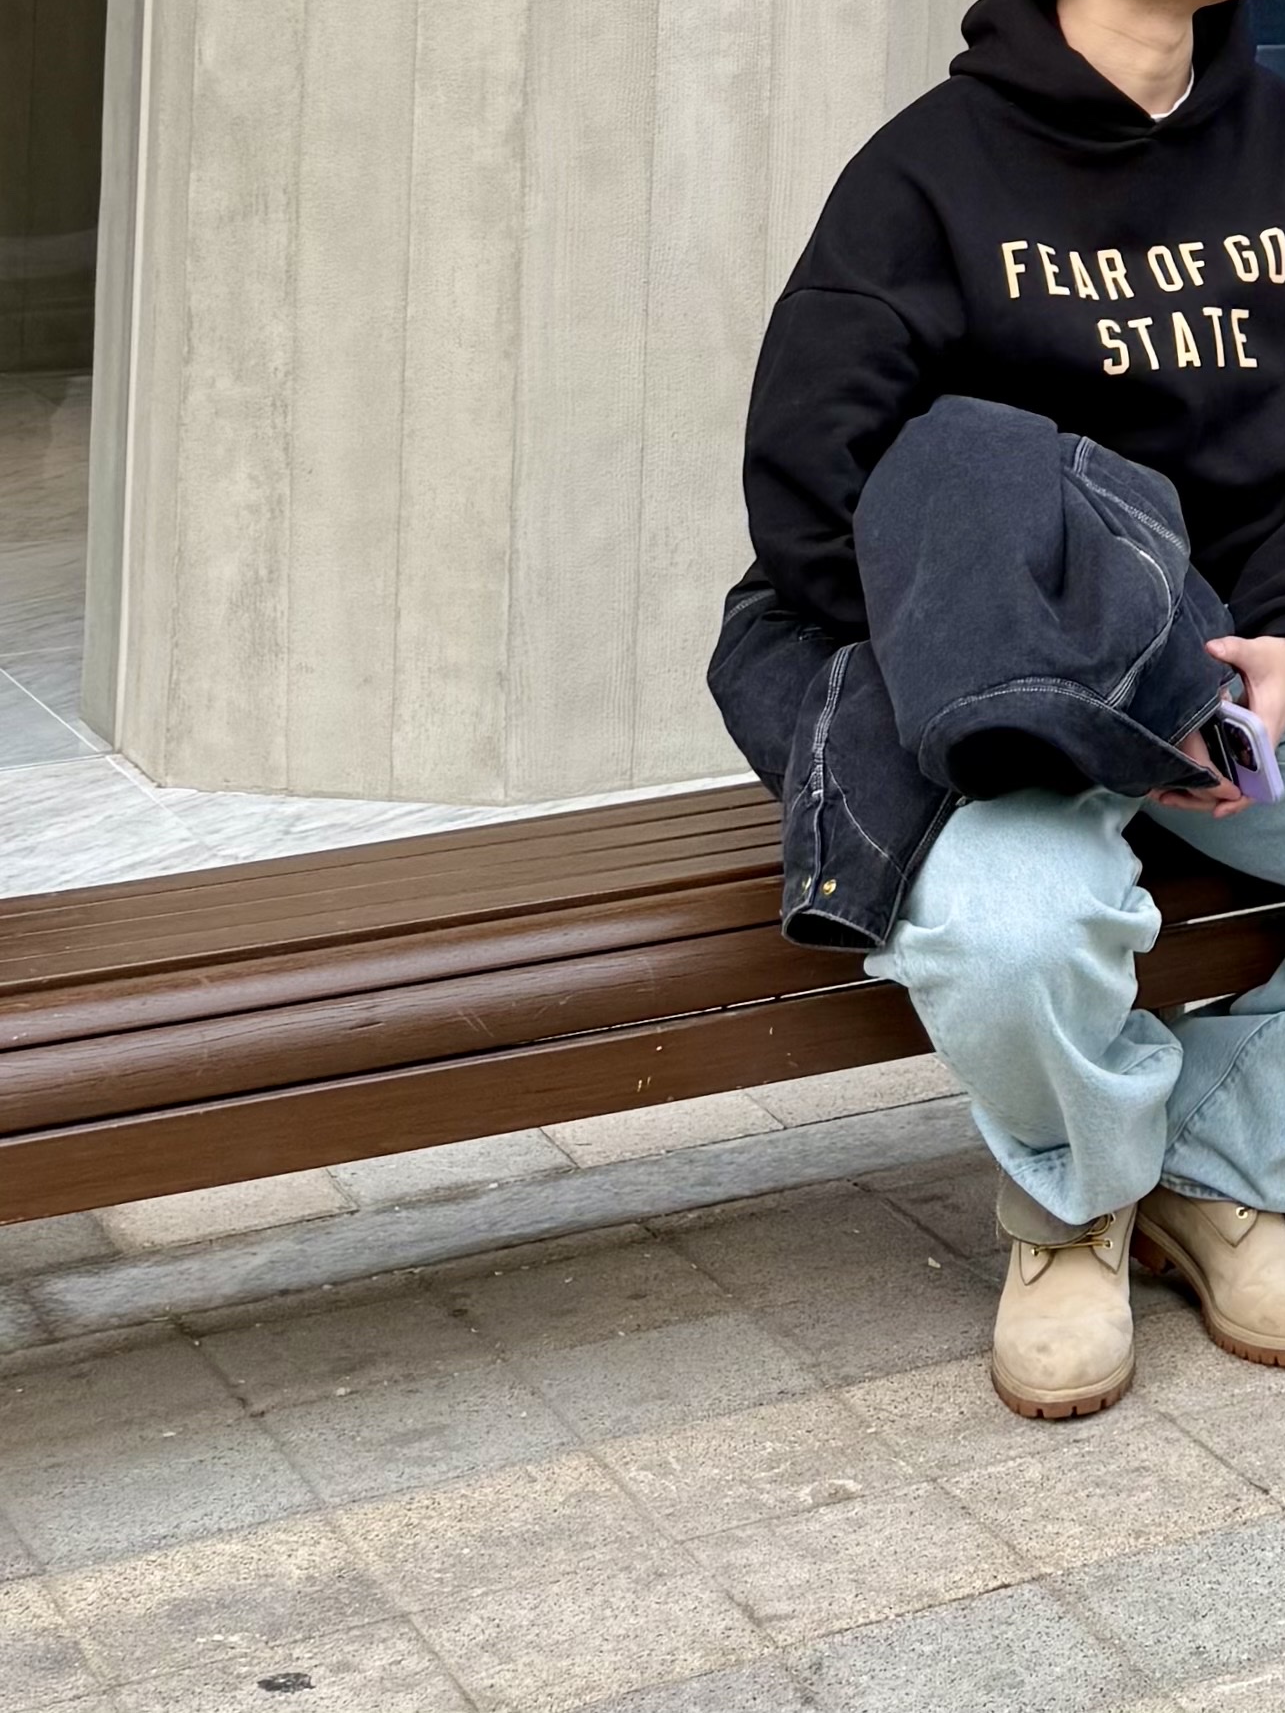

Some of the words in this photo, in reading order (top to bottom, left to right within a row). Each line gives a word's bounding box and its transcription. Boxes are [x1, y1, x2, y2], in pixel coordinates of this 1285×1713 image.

[1001, 240, 1135, 301] FEAR
[1147, 241, 1207, 293] OF
[1097, 306, 1259, 376] STATE
